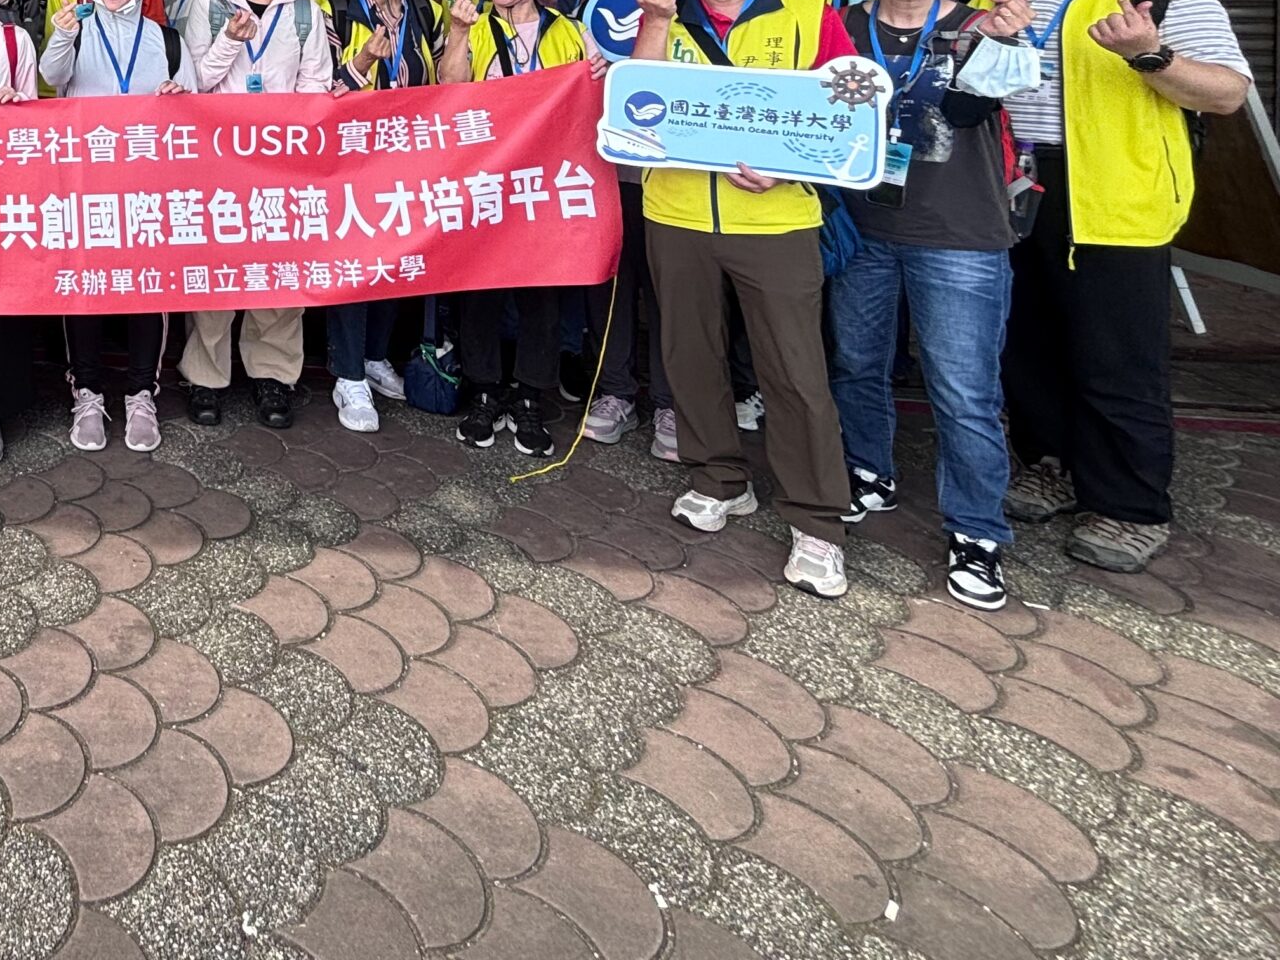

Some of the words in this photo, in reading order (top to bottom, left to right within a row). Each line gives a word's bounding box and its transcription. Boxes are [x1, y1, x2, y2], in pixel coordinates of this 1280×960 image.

[763, 36, 784, 69] 理事
[667, 118, 708, 129] National
[711, 122, 745, 132] Taiwan
[748, 126, 779, 136] Ocean
[781, 129, 835, 143] University
[669, 99, 853, 133] 國立臺灣海洋大學
